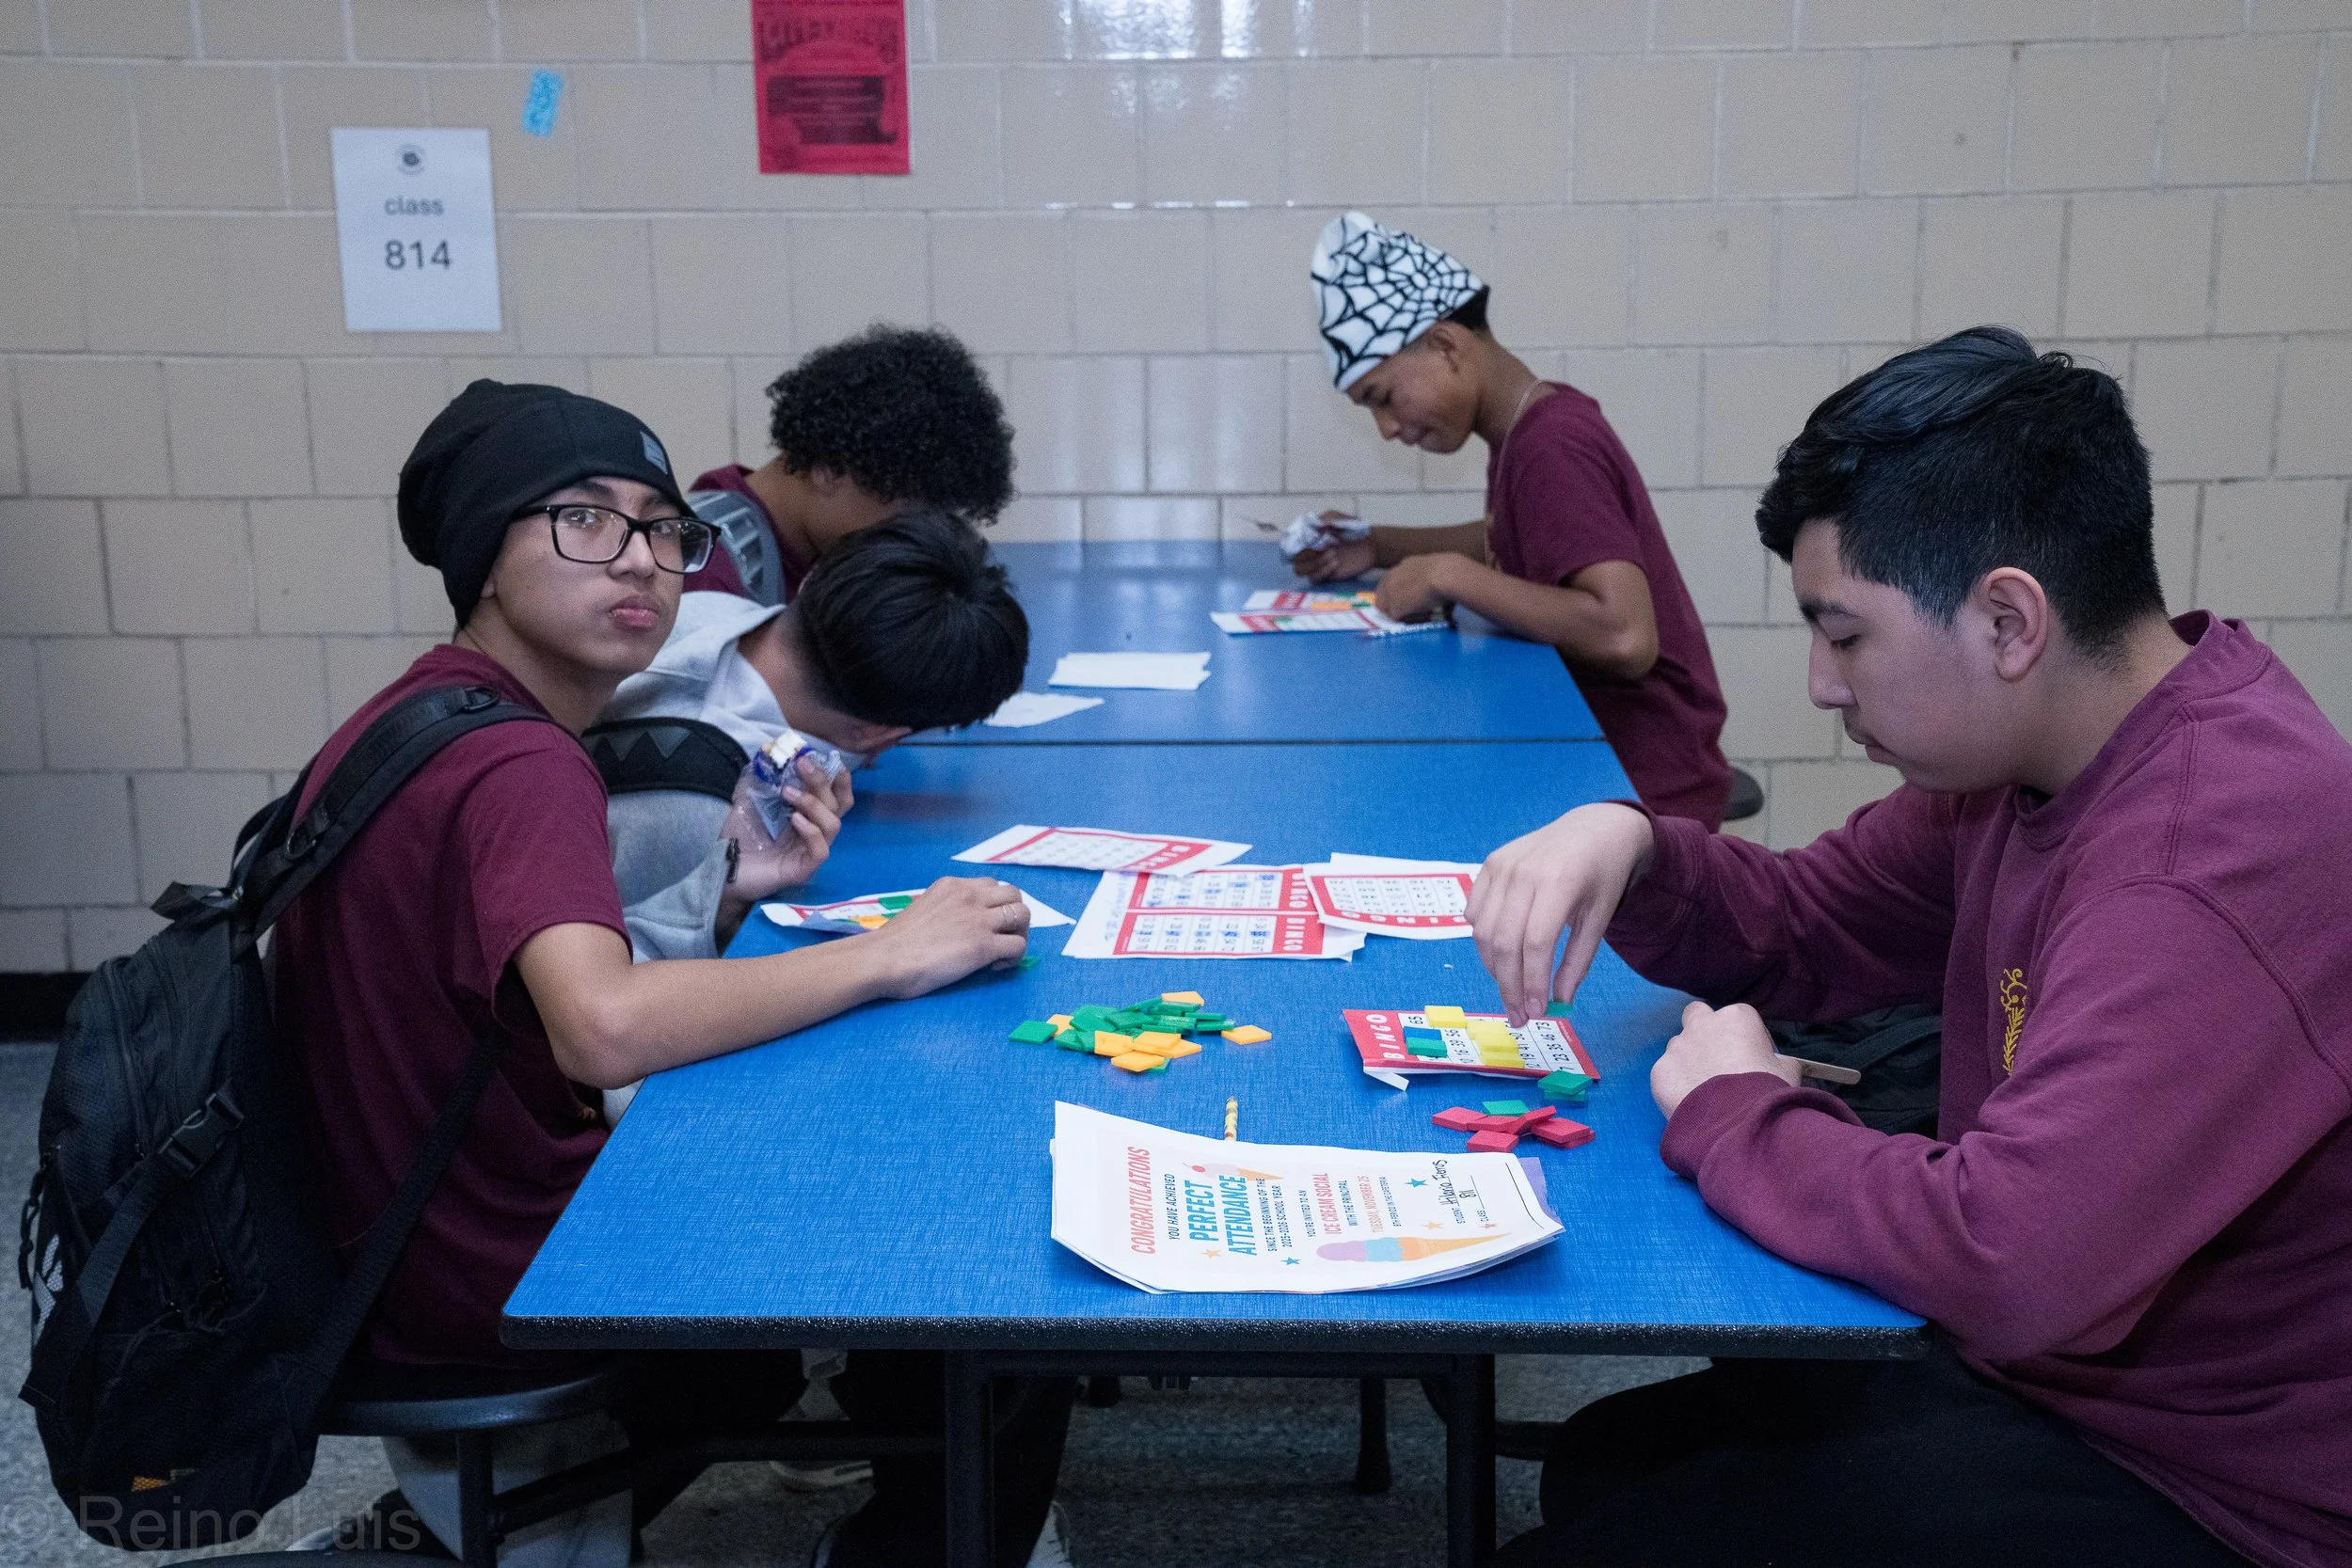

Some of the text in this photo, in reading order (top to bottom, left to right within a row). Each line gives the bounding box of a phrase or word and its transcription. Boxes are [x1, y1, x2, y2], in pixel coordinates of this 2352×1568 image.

[385, 195, 444, 215] class
[385, 239, 452, 270] 814
[1283, 917, 1306, 951] BINGO
[1408, 1016, 1423, 1024] 65
[1444, 1029, 1460, 1037] 56
[1535, 1022, 1551, 1030] 73
[1366, 1013, 1406, 1060] BINGO
[1358, 1175, 1370, 1183] 25
[1458, 1189, 1476, 1198] 811
[1127, 1146, 1155, 1254] CONGRATULATIONS
[1164, 1173, 1180, 1240] YOU HAVE ACHIEVED
[1184, 1180, 1218, 1242] PERFECT
[1301, 1203, 1312, 1221] INVITED
[1312, 1173, 1342, 1235] ICE CREAM SOCIAL
[1338, 1180, 1358, 1227] WITH THE PRINCIPAL
[1359, 1183, 1376, 1210] NOVEMBER
[1218, 1175, 1257, 1256] ATTENDANCE
[1256, 1178, 1278, 1252] SINCE THE BEGINNING OF THE
[1271, 1185, 1292, 1247] 2025-2026 SCHOOL YEAR
[1305, 1221, 1316, 1238] YOU'RE
[1476, 1210, 1489, 1222] CLASS
